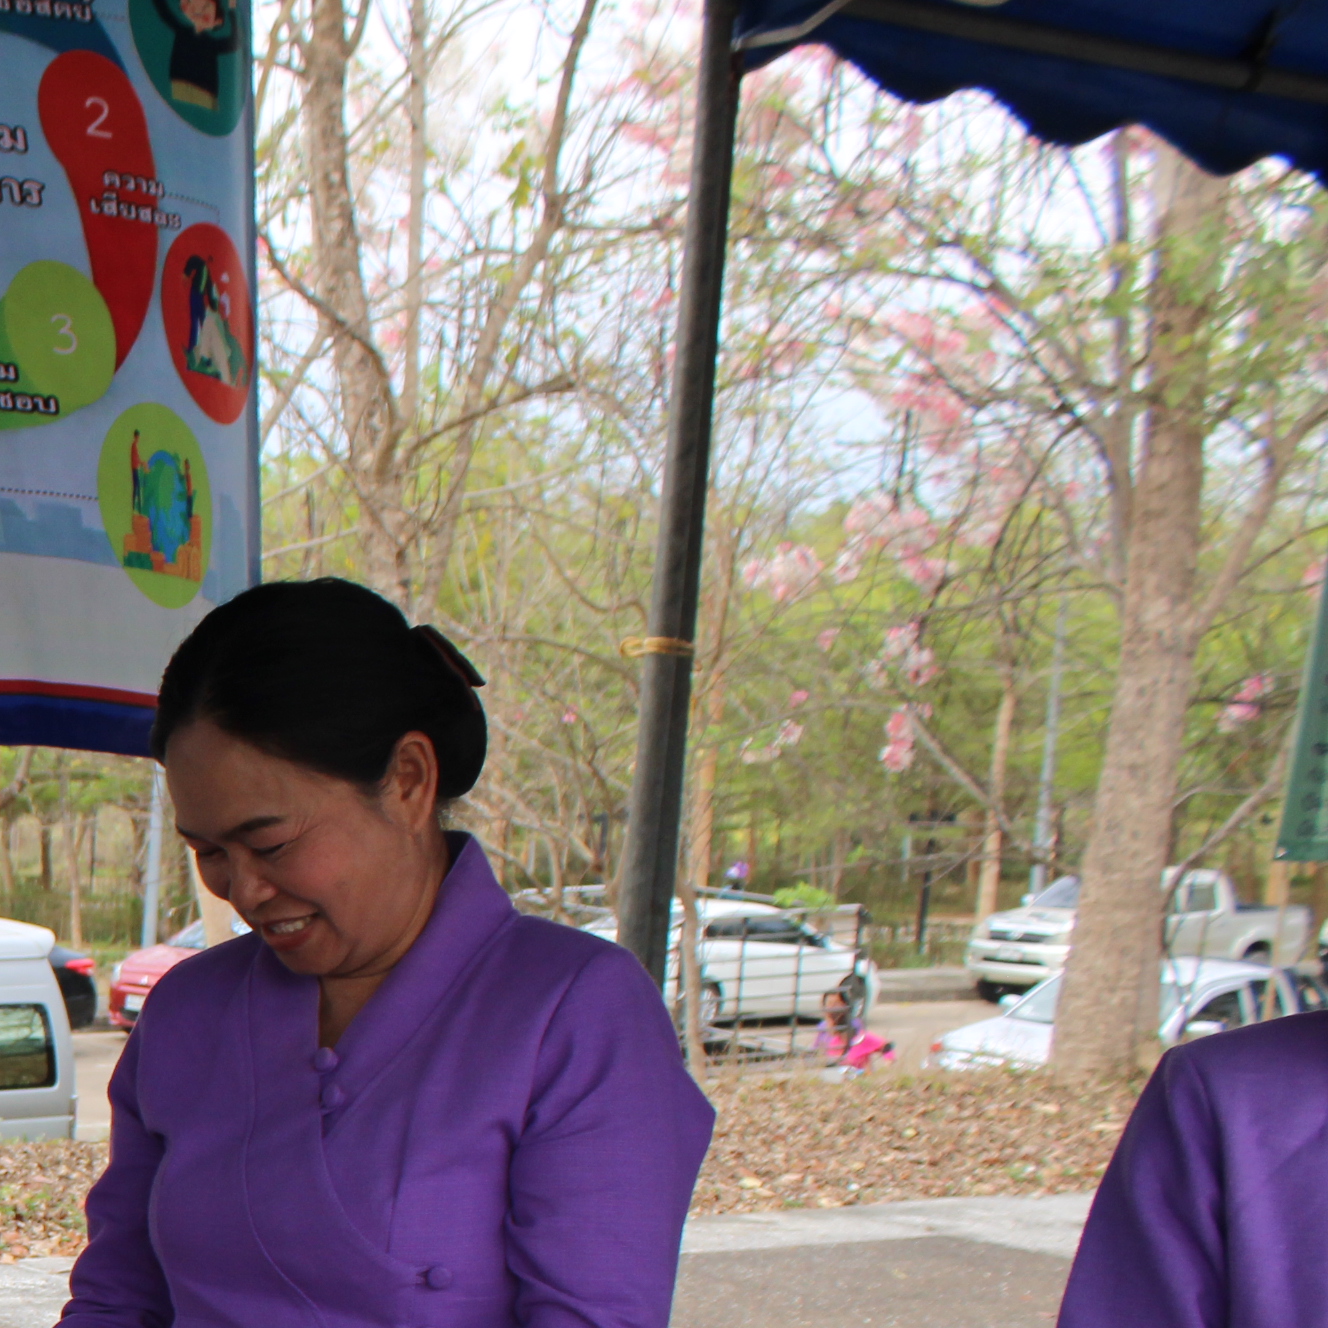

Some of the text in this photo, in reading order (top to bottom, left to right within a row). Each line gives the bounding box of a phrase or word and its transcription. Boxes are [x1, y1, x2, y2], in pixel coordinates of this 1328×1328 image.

[83, 96, 115, 139] 2
[103, 170, 165, 197] ความ
[49, 313, 79, 356] 3
